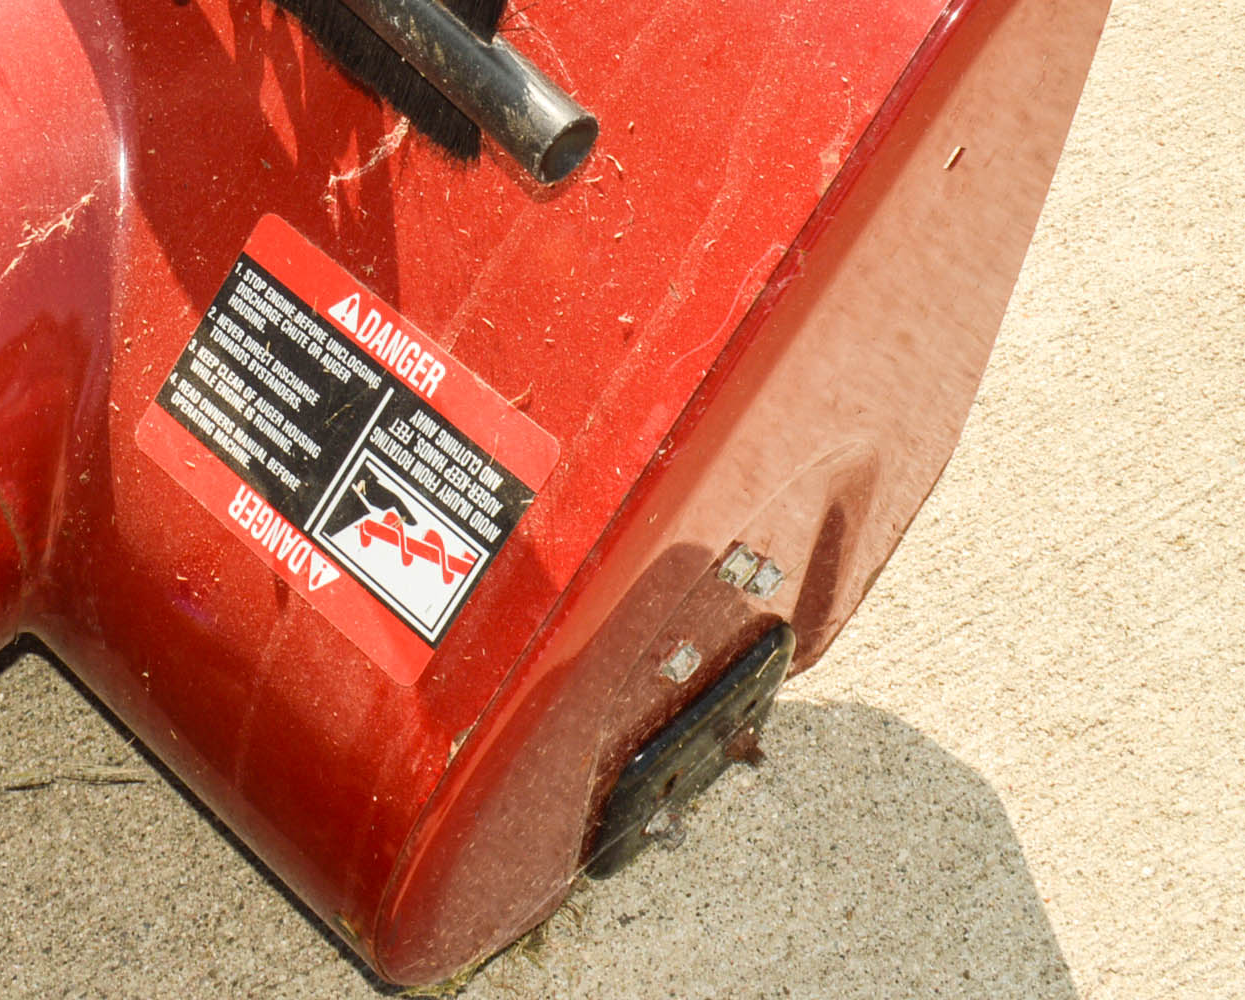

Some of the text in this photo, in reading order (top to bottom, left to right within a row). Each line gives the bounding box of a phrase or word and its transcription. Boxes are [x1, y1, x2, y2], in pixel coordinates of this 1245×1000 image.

[208, 306, 320, 406] 2. NEVER DIRECT DISCHARGE
[228, 294, 266, 333] HOUSING.
[235, 263, 382, 389] 1. STOP ENGINE BEFORE UNCLOGGING
[236, 281, 351, 383] DISCHARGE CHUTE OR AUGER
[355, 309, 446, 398] DANGER
[188, 339, 321, 459] 3. KEEP CLEAR OF AUGER HOUSING
[190, 358, 292, 455] WHILE ENGINE IS RUNNING.
[210, 325, 301, 412] TOWARDS BYSTANDERS.
[170, 373, 301, 492] 4. READ OWNERS MANUAL BEFORE
[171, 392, 251, 469] OPERATING MACHINE.
[388, 418, 503, 517] AUGER-KEEP HANDS, FEET
[409, 410, 503, 491] AND CLOTHING AWAY
[228, 485, 312, 574] DANGER
[370, 426, 501, 542] AVOID INJURY FROM ROTATING
